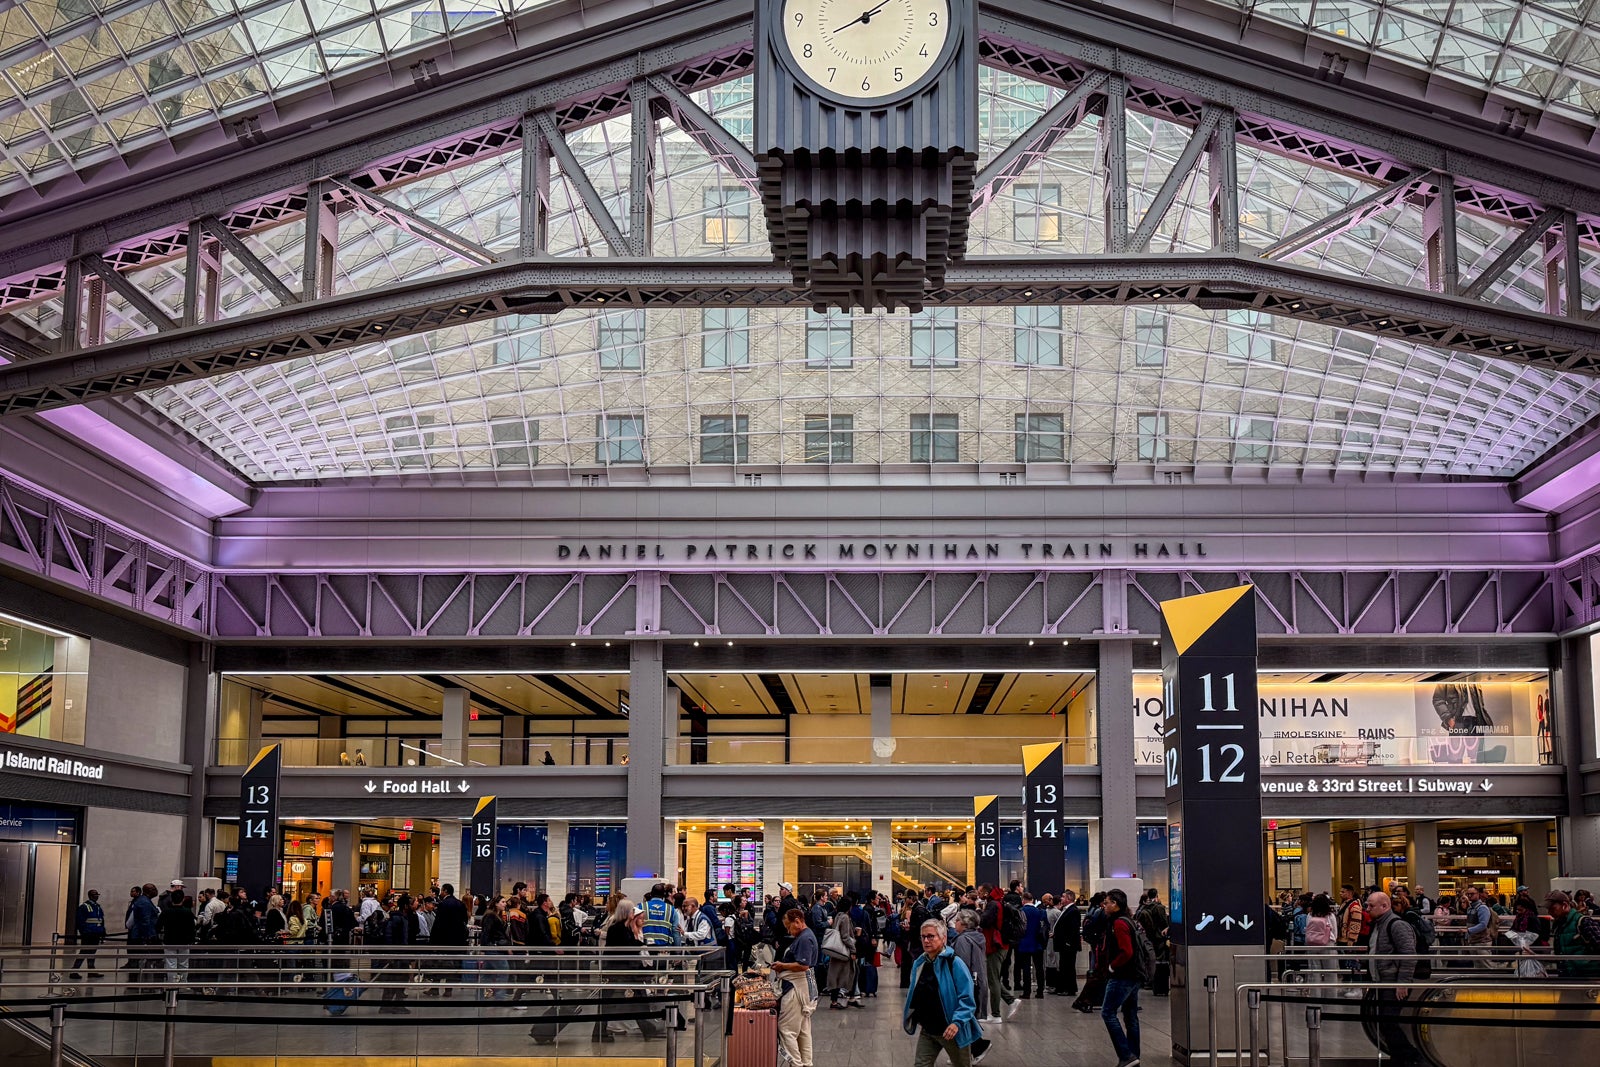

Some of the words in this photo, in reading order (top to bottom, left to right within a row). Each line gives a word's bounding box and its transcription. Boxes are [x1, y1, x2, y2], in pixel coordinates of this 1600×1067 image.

[794, 13, 804, 27] 9
[928, 12, 938, 27] 3
[803, 43, 813, 58] 8
[918, 43, 929, 58] 4
[827, 67, 837, 83] 7
[894, 67, 903, 82] 5
[861, 76, 870, 91] 6
[557, 544, 665, 559] DANIEL
[687, 544, 817, 559] PATRICK
[839, 543, 1000, 559] MOYNIHAN
[1021, 543, 1113, 559] TRAIN
[1134, 543, 1207, 558] HALL
[1198, 672, 1239, 711] 11
[1281, 730, 1343, 738] MOLESKINE
[1358, 728, 1396, 740] RAINS
[1449, 726, 1468, 734] bone
[1196, 743, 1245, 783] 12
[1259, 750, 1281, 763] vel
[6, 750, 47, 771] Island
[48, 757, 72, 775] Rail
[73, 761, 104, 779] Road
[1166, 747, 1178, 788] 12
[383, 780, 417, 793] Food
[421, 780, 451, 793] Hall
[1307, 779, 1319, 792] &
[1322, 779, 1355, 792] 33rd
[1358, 779, 1403, 792] Street
[1418, 778, 1473, 794] Subway
[247, 785, 269, 805] 13
[1033, 784, 1057, 804] 13
[245, 818, 269, 839] 14
[476, 822, 491, 836] 15
[980, 822, 995, 835] 15
[1033, 818, 1058, 838] 14
[1439, 838, 1454, 846] rag
[1464, 837, 1482, 845] bone
[476, 844, 491, 857] 16
[980, 843, 996, 857] 16
